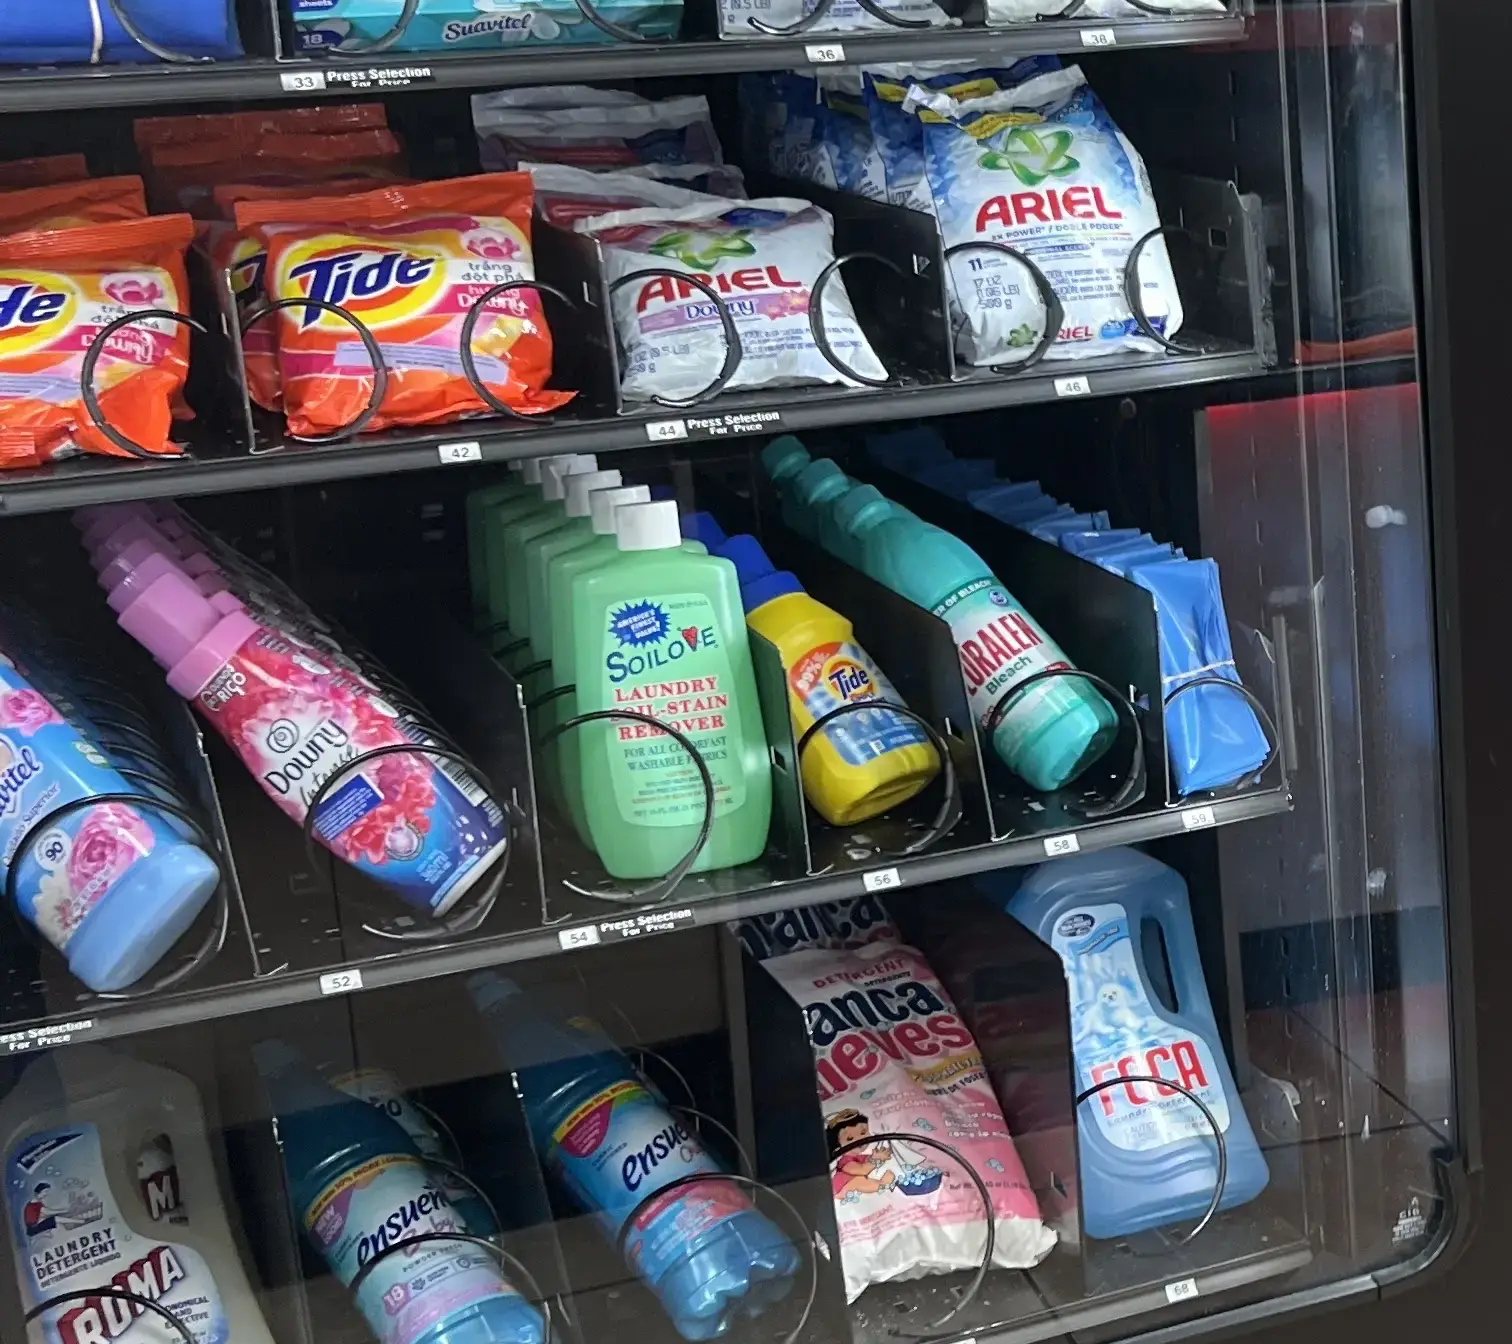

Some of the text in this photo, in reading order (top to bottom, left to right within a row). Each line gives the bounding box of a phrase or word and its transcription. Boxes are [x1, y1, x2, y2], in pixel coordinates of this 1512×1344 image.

[299, 0, 333, 8] sheets
[445, 14, 531, 41] Suavitel
[303, 35, 323, 44] 18
[817, 50, 835, 60] 36
[293, 66, 431, 88] 33 Press Selection
[351, 77, 410, 88] For Price
[975, 186, 1121, 233] ARIEL
[969, 258, 983, 271] 11
[288, 252, 436, 328] Tide
[637, 266, 801, 313] ARIEL
[1065, 382, 1081, 392] 46
[659, 412, 779, 436] 44 Press Selection
[710, 423, 762, 434] For Price
[452, 447, 469, 458] 42
[945, 579, 991, 606] OF BLEACH
[829, 667, 870, 700] Tide
[985, 655, 1032, 695] Bleach
[615, 677, 717, 702] LAUNDRY
[619, 715, 725, 740] REMOVER
[264, 718, 348, 794] Downy
[624, 742, 666, 759] FOR ALL
[628, 752, 684, 771] WASHABLE
[1192, 813, 1206, 824] 59
[45, 841, 63, 861] 90
[1054, 839, 1070, 851] 58
[875, 875, 891, 886] 56
[571, 910, 692, 944] 54 Press Selection
[622, 921, 674, 936] For Price
[332, 976, 350, 988] 52
[812, 958, 904, 989] DETERGENT
[28, 1019, 92, 1039] Selection
[10, 1032, 72, 1052] For Price
[1090, 1040, 1209, 1117] FOCA
[33, 1227, 113, 1267] LAUNDRY
[36, 1240, 117, 1280] DETERGENT
[385, 1286, 404, 1307] 18
[1174, 1284, 1188, 1296] 68
